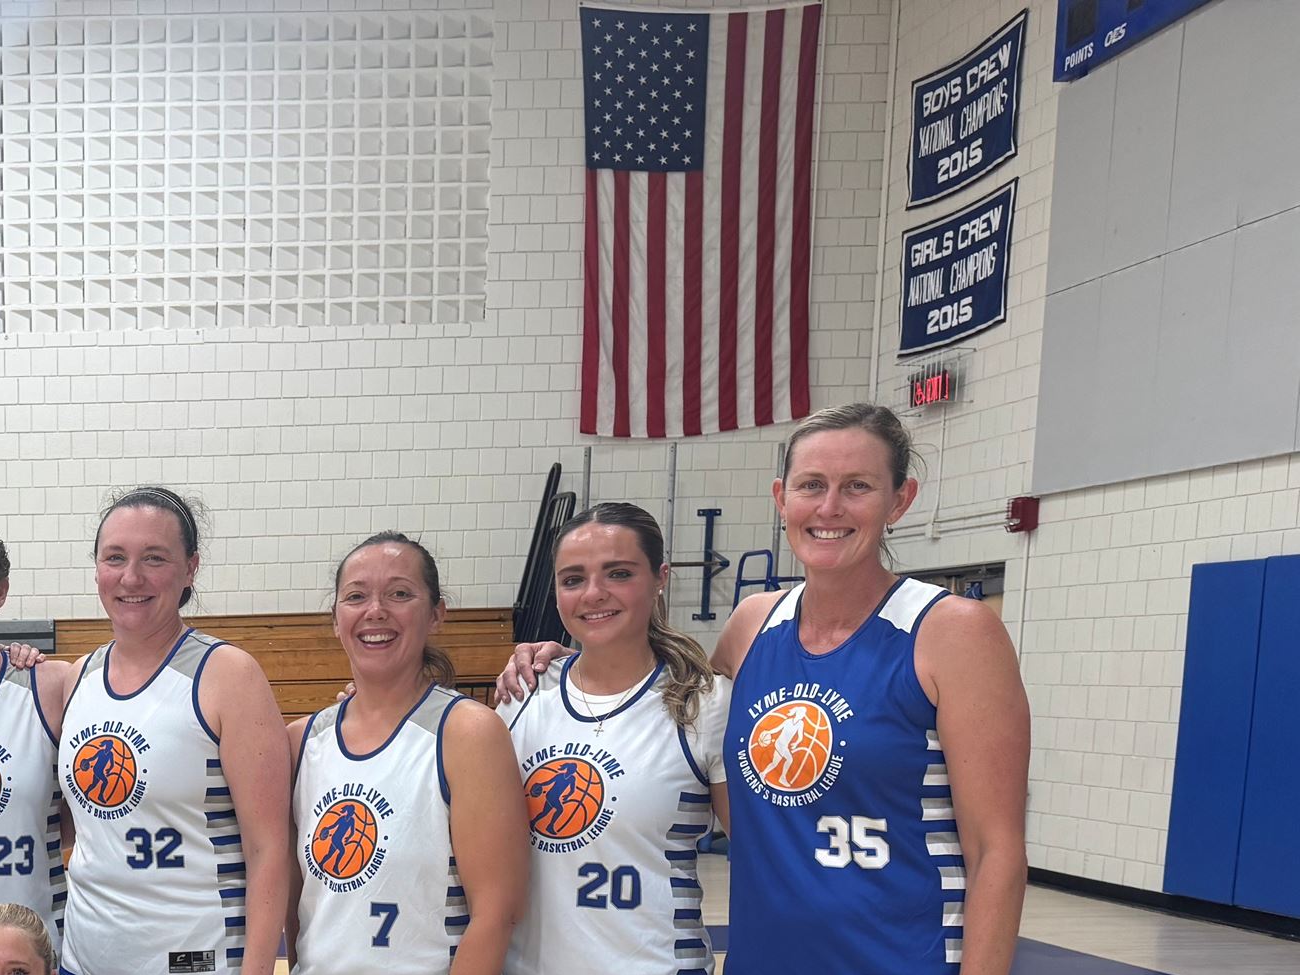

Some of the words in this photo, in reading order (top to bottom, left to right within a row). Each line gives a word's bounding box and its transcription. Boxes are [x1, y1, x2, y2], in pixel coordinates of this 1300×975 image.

[1064, 42, 1094, 72] POINTS
[923, 76, 961, 117] BOYS
[966, 41, 1011, 95] CREW
[919, 113, 955, 158] NATIONAL
[960, 78, 1008, 140] CHAMPIONS
[937, 138, 982, 184] 2015
[911, 230, 954, 268] GIRLS
[958, 205, 1003, 250] CREW
[907, 267, 945, 307] NATIONAL
[950, 242, 998, 294] CHAMPIONS
[926, 296, 973, 335] 2015
[748, 683, 854, 723] LYME-OLD-LYME
[69, 720, 151, 755] LYME-OLD-LYME
[522, 742, 625, 780] LYME-OLD-LYME
[819, 754, 844, 791] LEAGUE
[129, 779, 147, 807] LEAGUE
[313, 783, 394, 820] LYME-OLD-LYME
[589, 807, 614, 841] LEAGUE
[815, 815, 890, 869] 35
[125, 827, 185, 869] 32
[364, 847, 386, 879] LEAGUE
[576, 862, 642, 910] 20
[370, 902, 400, 947] 7
